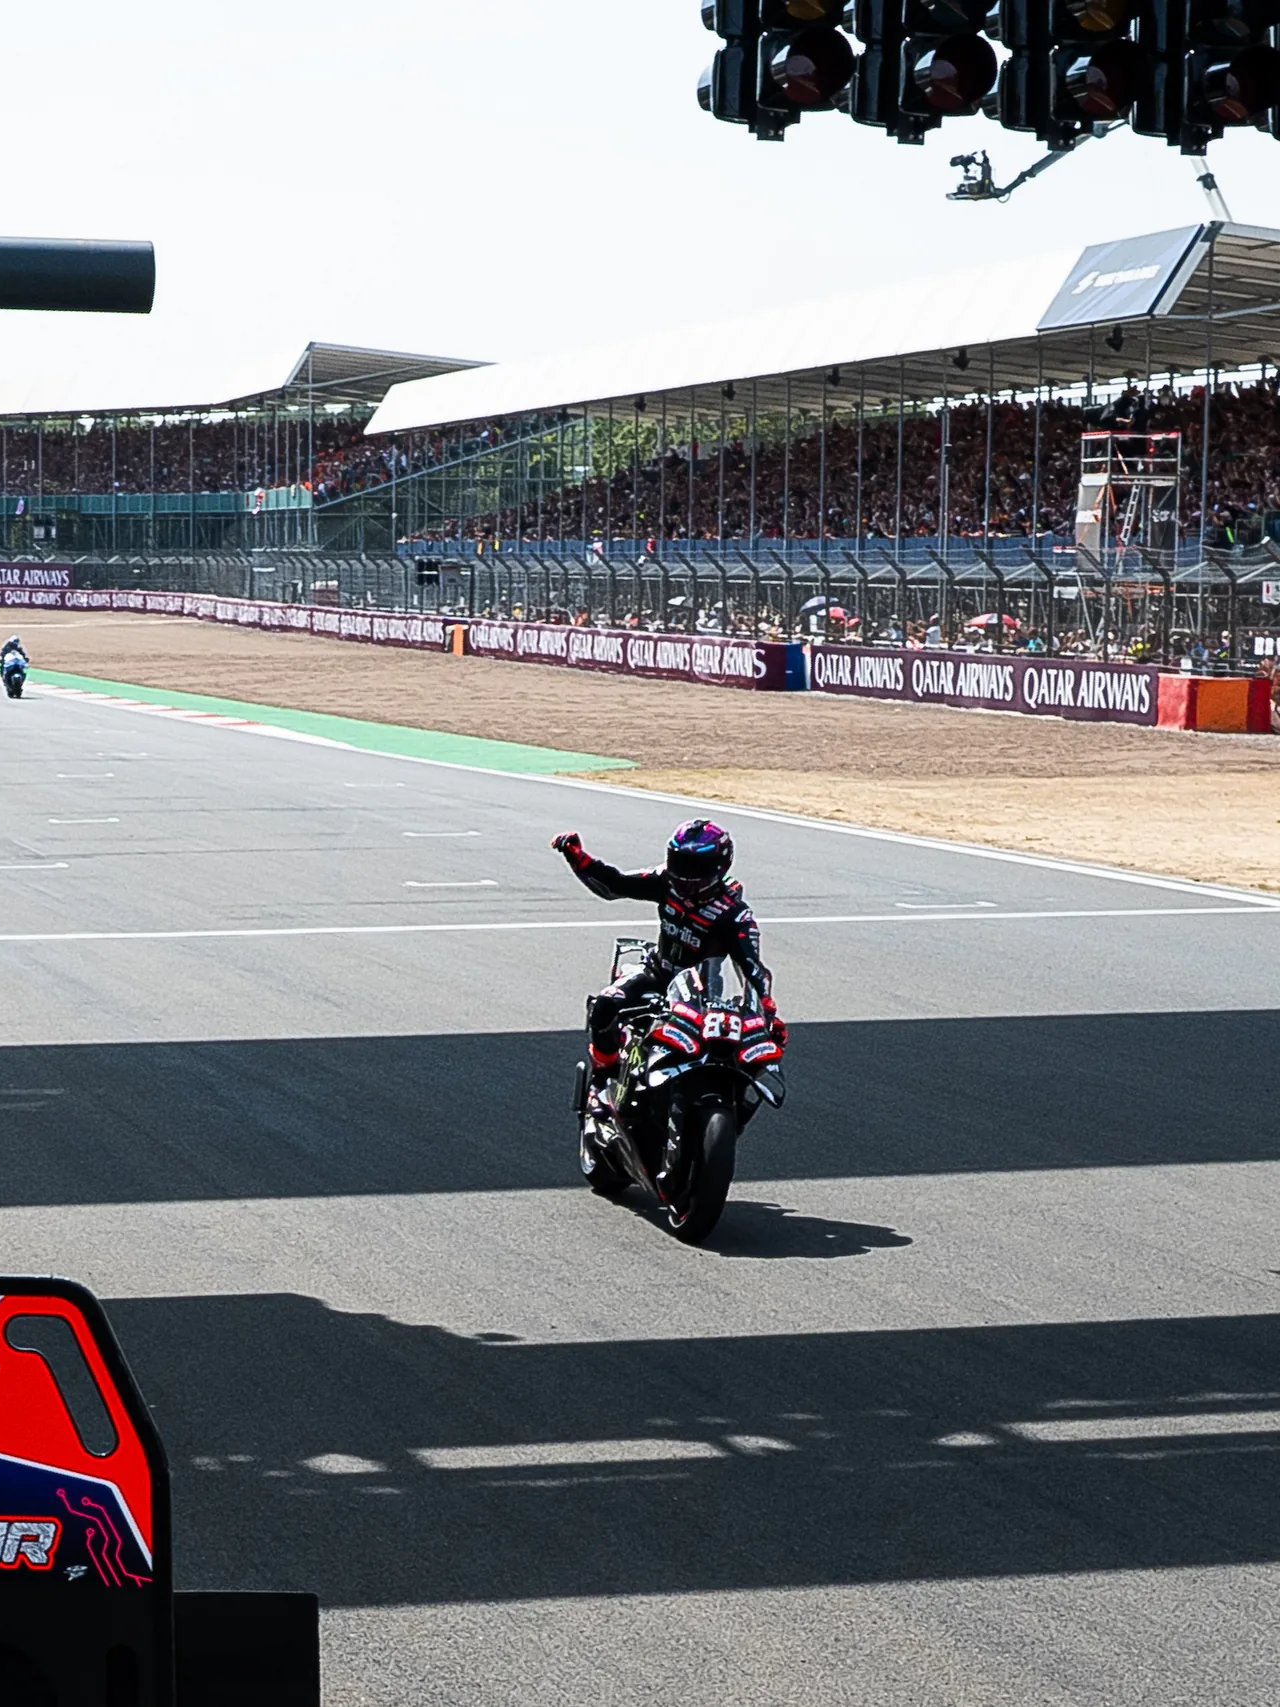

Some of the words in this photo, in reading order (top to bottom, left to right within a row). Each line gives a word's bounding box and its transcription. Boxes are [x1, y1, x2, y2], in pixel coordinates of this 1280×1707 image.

[22, 569, 70, 587] AIRWAYS
[692, 643, 721, 675] QATAR
[814, 652, 852, 688] QATAR
[853, 656, 905, 692] AIRWAYS
[911, 658, 955, 697] QATAR
[955, 662, 1014, 702] AIRWAYS
[1023, 667, 1075, 710] QATAR
[1076, 670, 1151, 714] AIRWAYS
[660, 918, 701, 949] aprilia
[702, 1012, 742, 1041] 89
